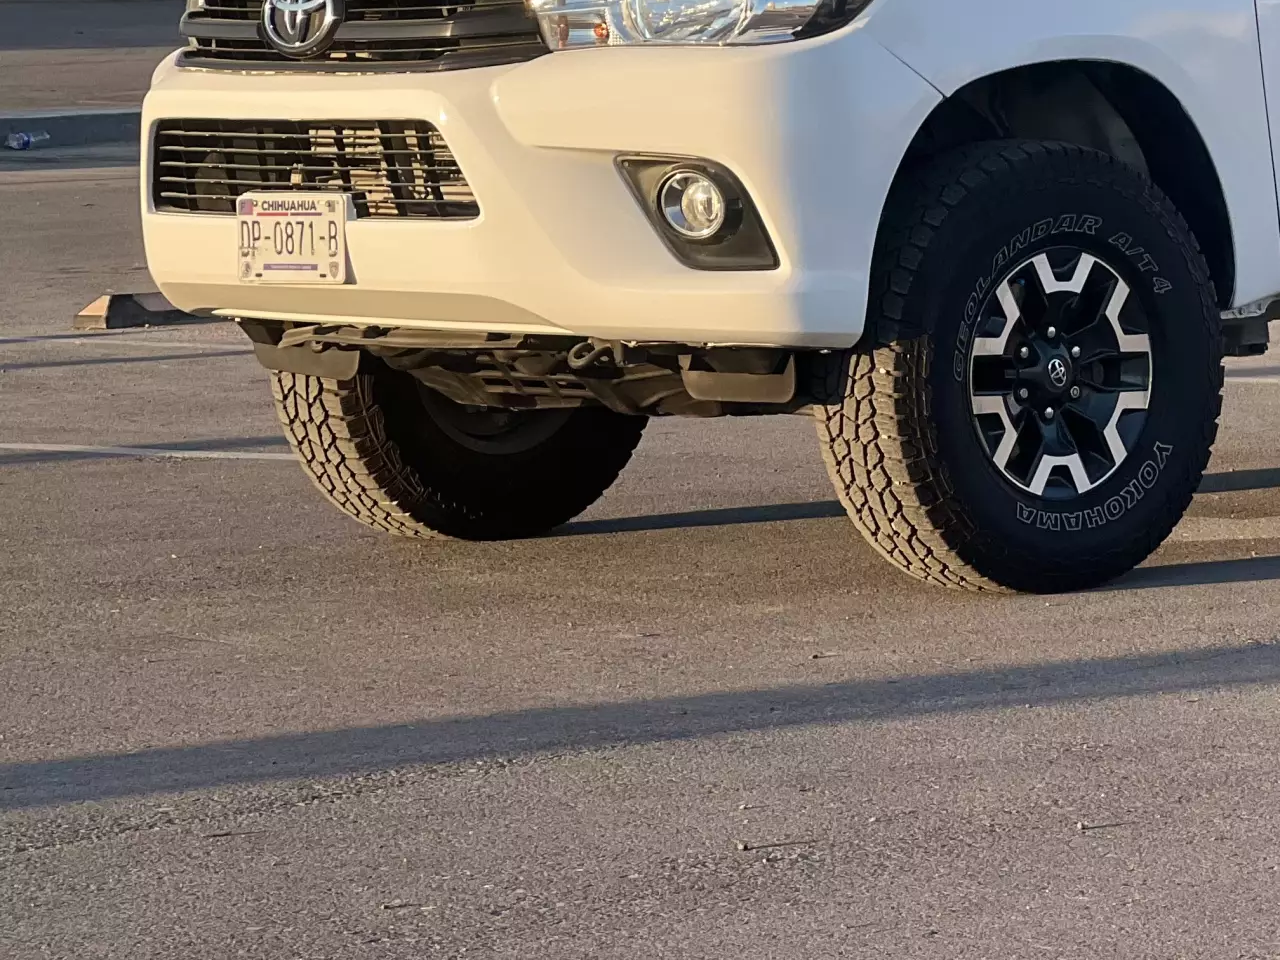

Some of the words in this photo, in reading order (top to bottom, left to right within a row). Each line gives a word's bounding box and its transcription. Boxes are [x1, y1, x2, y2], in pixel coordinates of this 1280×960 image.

[261, 200, 317, 212] CHIHUAHUA
[240, 220, 339, 258] DP-0871-B
[953, 214, 1102, 382] GEOLANDAR
[1016, 441, 1173, 530] YOKOHAMA
